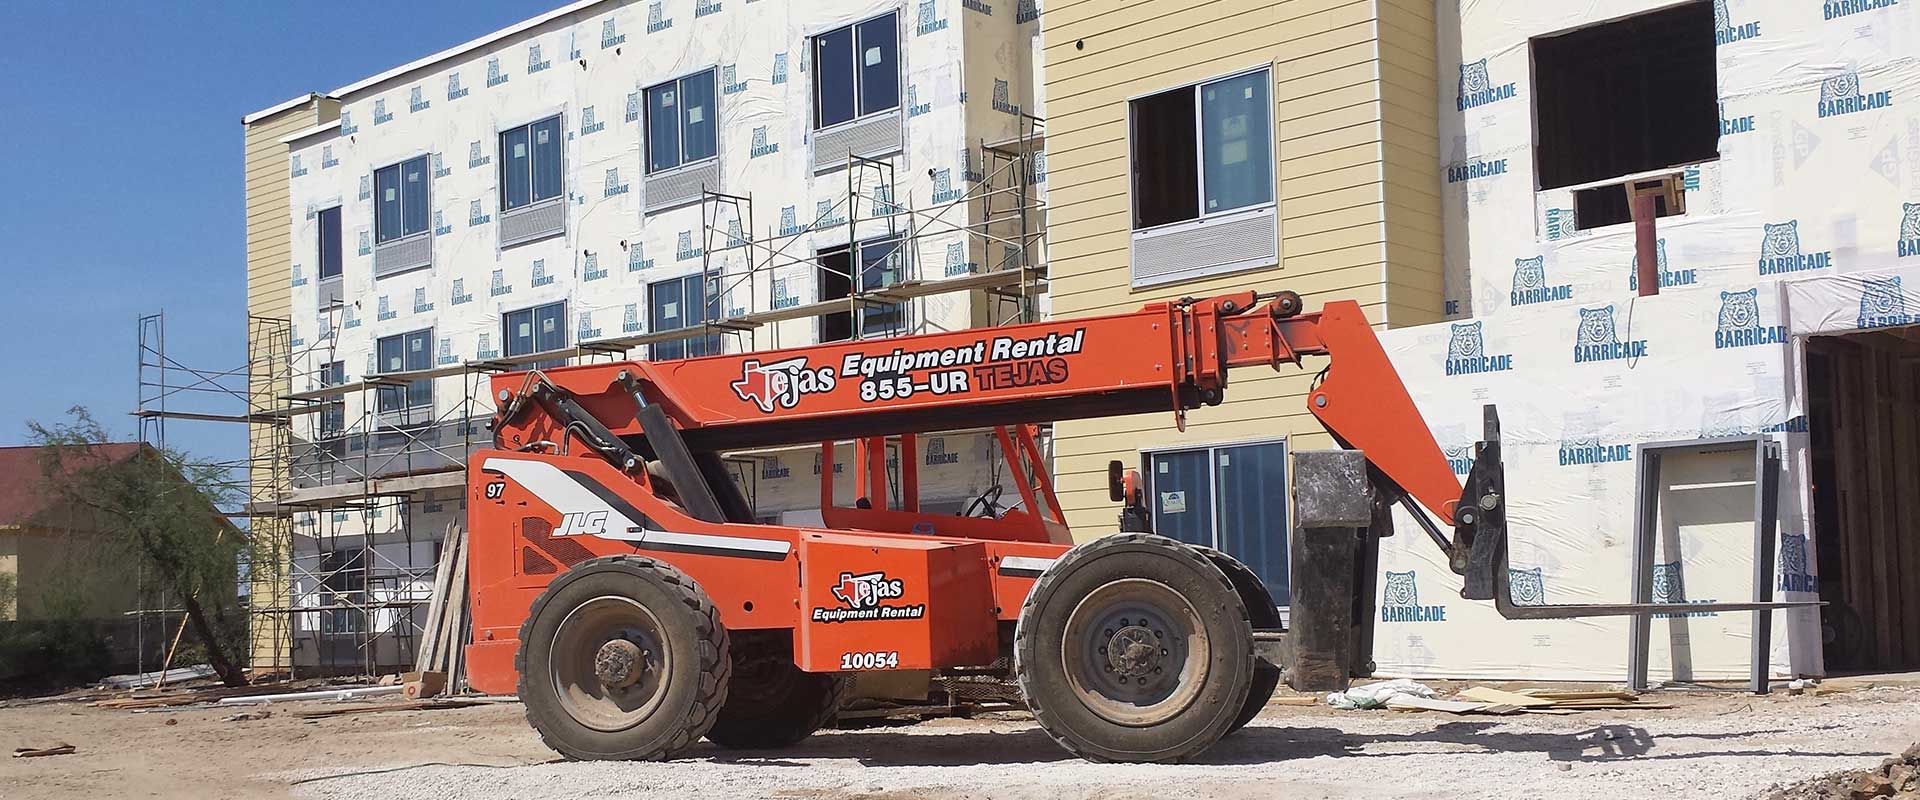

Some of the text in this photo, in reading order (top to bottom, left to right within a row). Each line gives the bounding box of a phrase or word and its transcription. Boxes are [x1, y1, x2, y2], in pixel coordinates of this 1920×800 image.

[1715, 21, 1762, 46] RICADE
[1456, 82, 1517, 112] BARRICADE
[1818, 90, 1893, 118] BARRICADE
[1448, 159, 1508, 183] BARRICADE
[1759, 251, 1832, 276] BARRICADE
[1511, 285, 1573, 306] BARRICADE
[841, 343, 986, 378] Equipment
[989, 330, 1083, 362] Rental
[1574, 339, 1648, 363] BARRICADE
[1445, 354, 1513, 376] BARRICADE
[860, 359, 1068, 402] 855-UR TEJAS
[1559, 443, 1632, 466] BARRICADE
[486, 482, 505, 498] 97
[552, 511, 608, 536] JLG
[813, 605, 923, 621] Equipment Rental
[1381, 605, 1447, 622] BARRICADE
[841, 652, 898, 670] 10054
